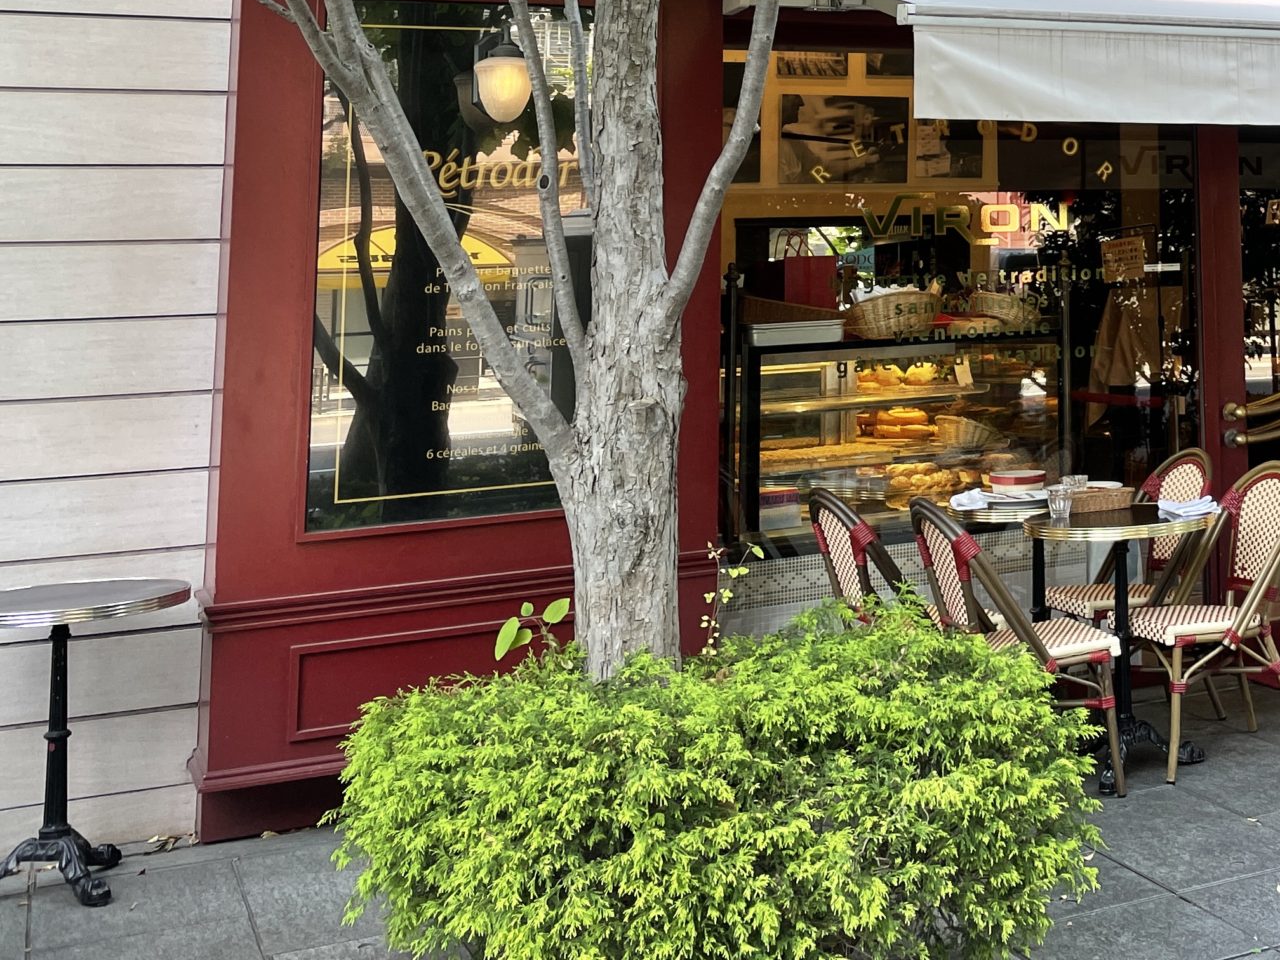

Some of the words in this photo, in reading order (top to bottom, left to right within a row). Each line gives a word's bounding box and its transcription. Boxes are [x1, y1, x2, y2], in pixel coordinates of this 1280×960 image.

[1120, 145, 1263, 184] VIRN
[860, 192, 1070, 246] VIRON
[424, 283, 441, 294] de
[429, 325, 463, 338] Pains
[416, 342, 447, 354] dans
[450, 341, 462, 352] le
[426, 448, 434, 459] 6
[510, 441, 546, 455] graine
